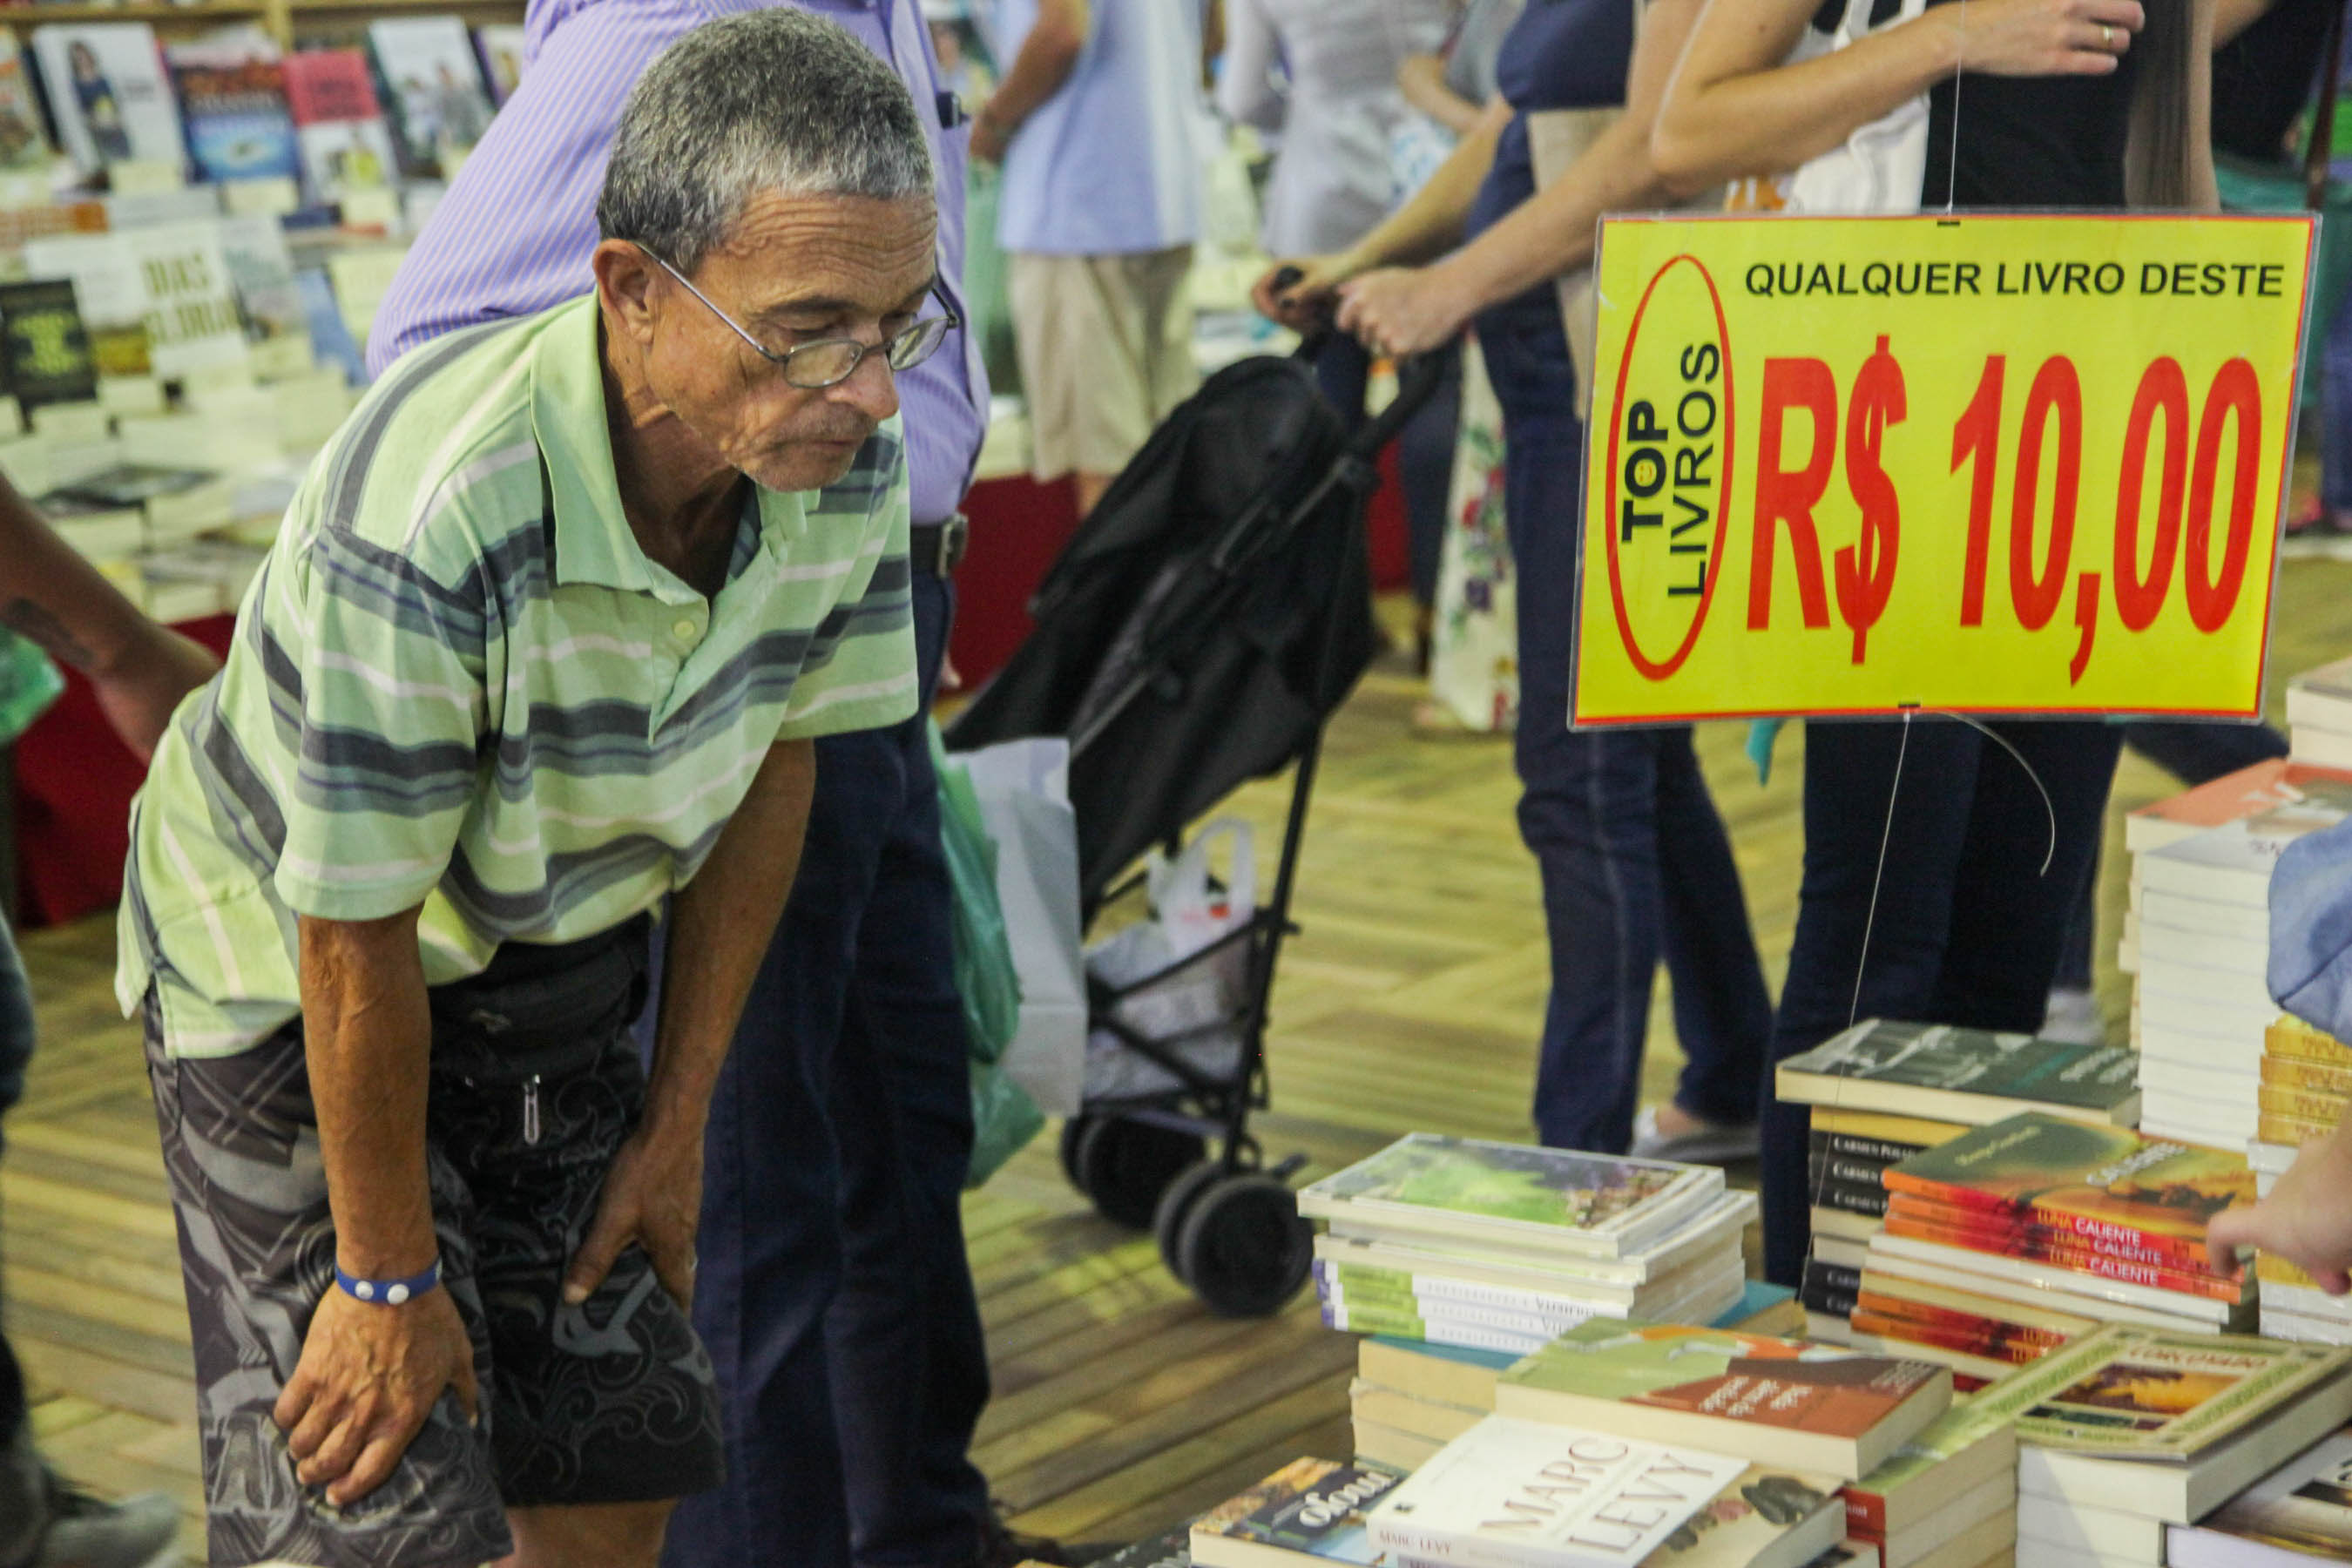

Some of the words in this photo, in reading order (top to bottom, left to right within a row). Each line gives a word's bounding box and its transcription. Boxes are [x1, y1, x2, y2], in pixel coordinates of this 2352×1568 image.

[1745, 261, 1982, 297] QUALQUER
[1996, 262, 2126, 294] LIVRO
[2139, 263, 2286, 298] DESTE
[1621, 400, 1669, 544] TOP
[1667, 342, 1720, 598] LIVROS
[1746, 335, 1909, 666] R$
[1950, 354, 2263, 688] 10,00
[2075, 1216, 2141, 1247] CALIENTE
[2093, 1238, 2162, 1266] CALIENTE
[2090, 1257, 2159, 1287] CALIENTE
[1477, 1436, 1629, 1537] MARC
[1566, 1451, 1715, 1554] LEVY
[1419, 1536, 1451, 1555] LEVY
